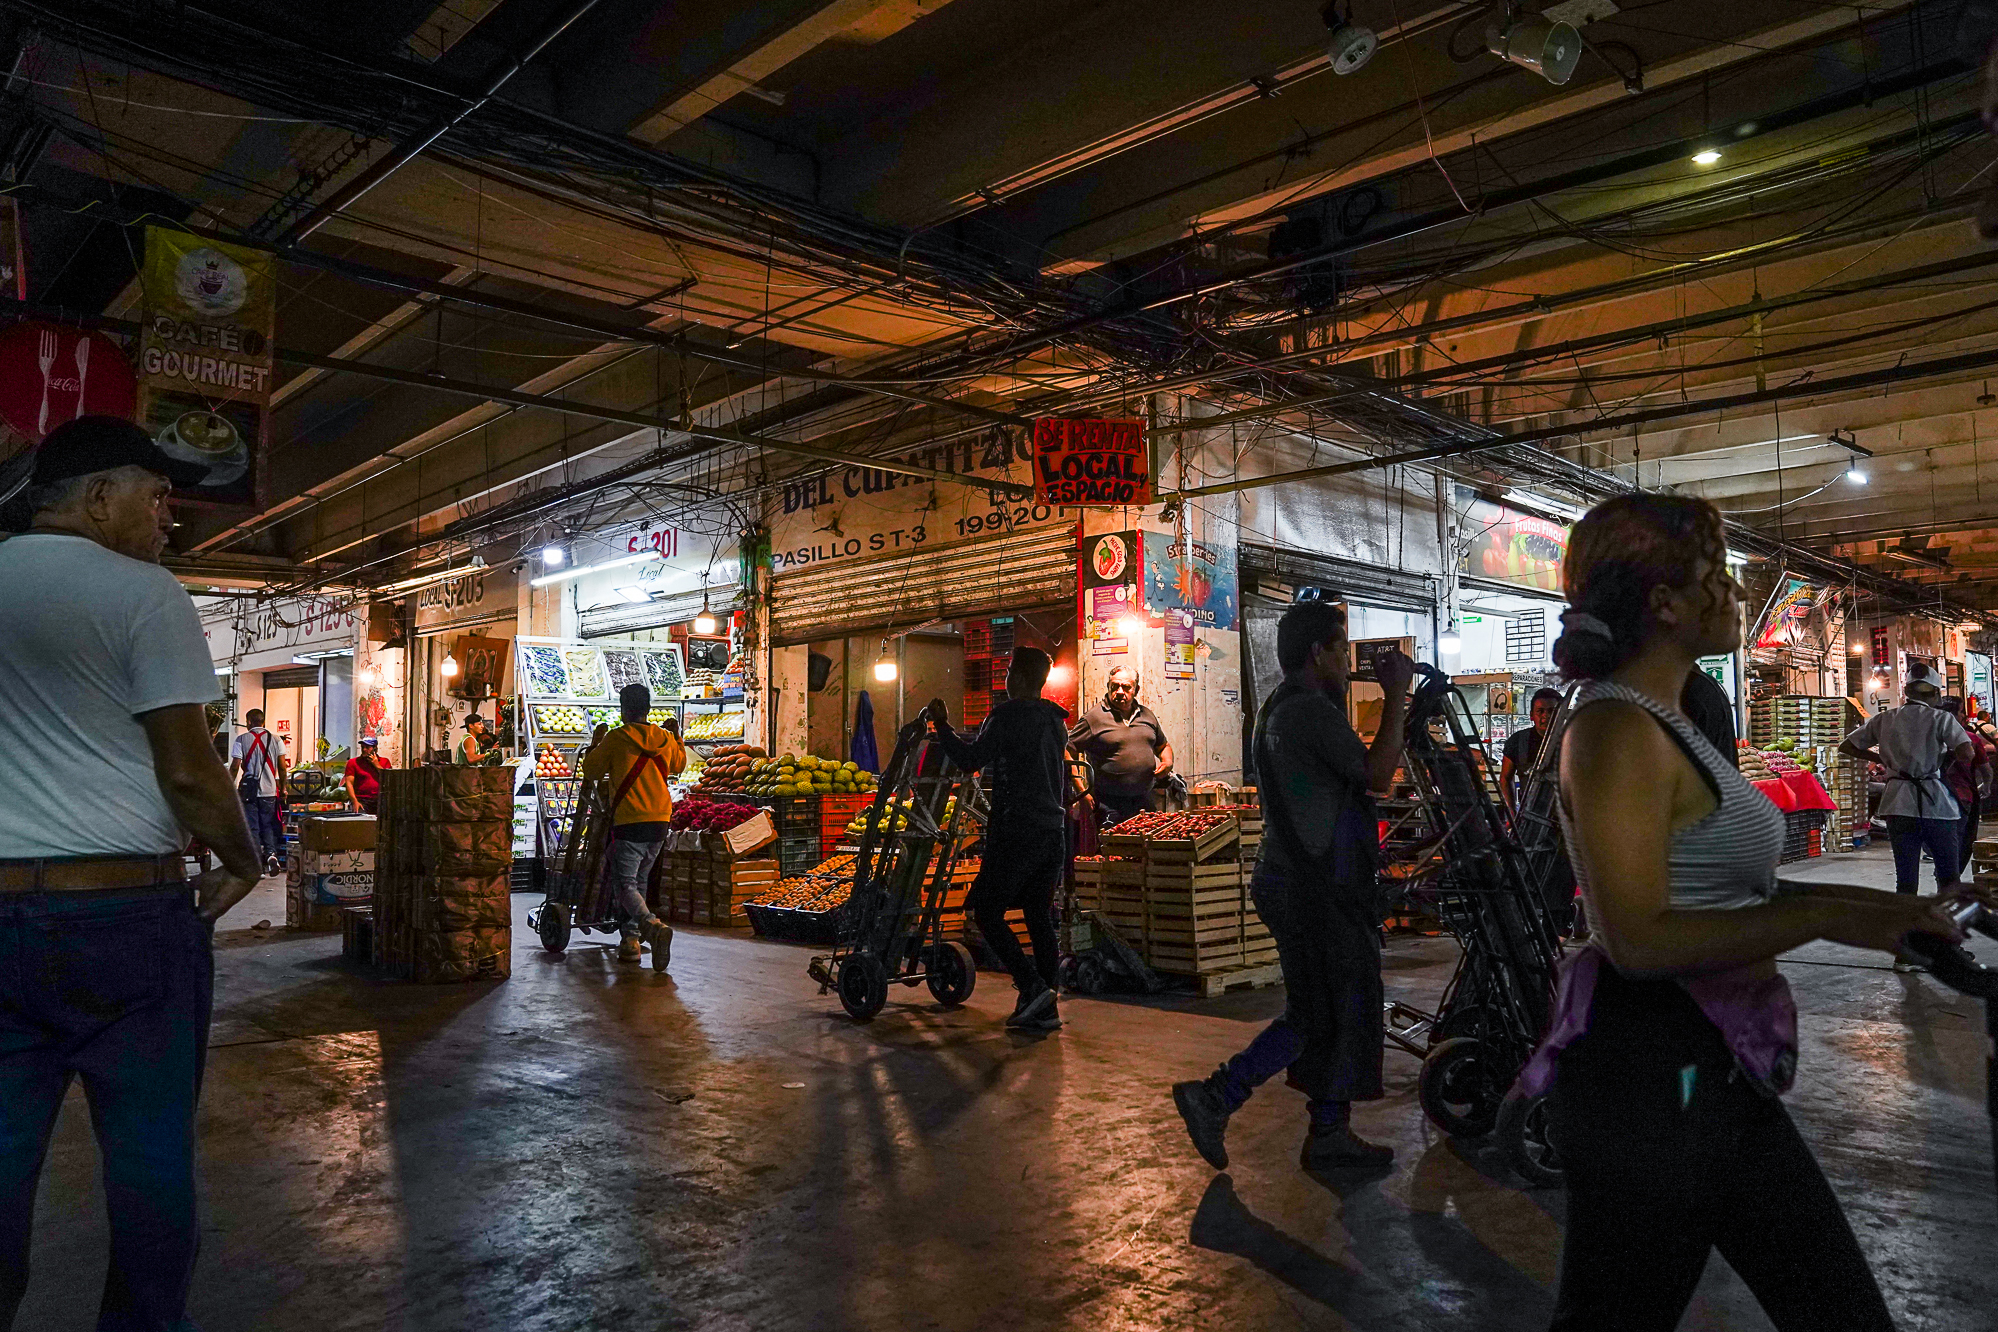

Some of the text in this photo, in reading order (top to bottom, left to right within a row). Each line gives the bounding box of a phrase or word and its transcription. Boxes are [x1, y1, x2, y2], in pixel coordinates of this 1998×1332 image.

[152, 315, 240, 353] CAFÉ
[143, 346, 270, 393] GOURMET
[1037, 418, 1142, 453] SE RENTA
[1038, 454, 1139, 484] LOCAL
[783, 475, 835, 514] DEL
[1045, 481, 1135, 504] ESPACIO
[1461, 527, 1480, 543] asillo
[1515, 517, 1562, 542] Frutas Finas
[771, 538, 862, 570] PASILLO
[1167, 544, 1216, 564] Straerries
[638, 563, 666, 582] Local
[1377, 645, 1394, 654] AT&T
[336, 873, 374, 884] NORDIC
